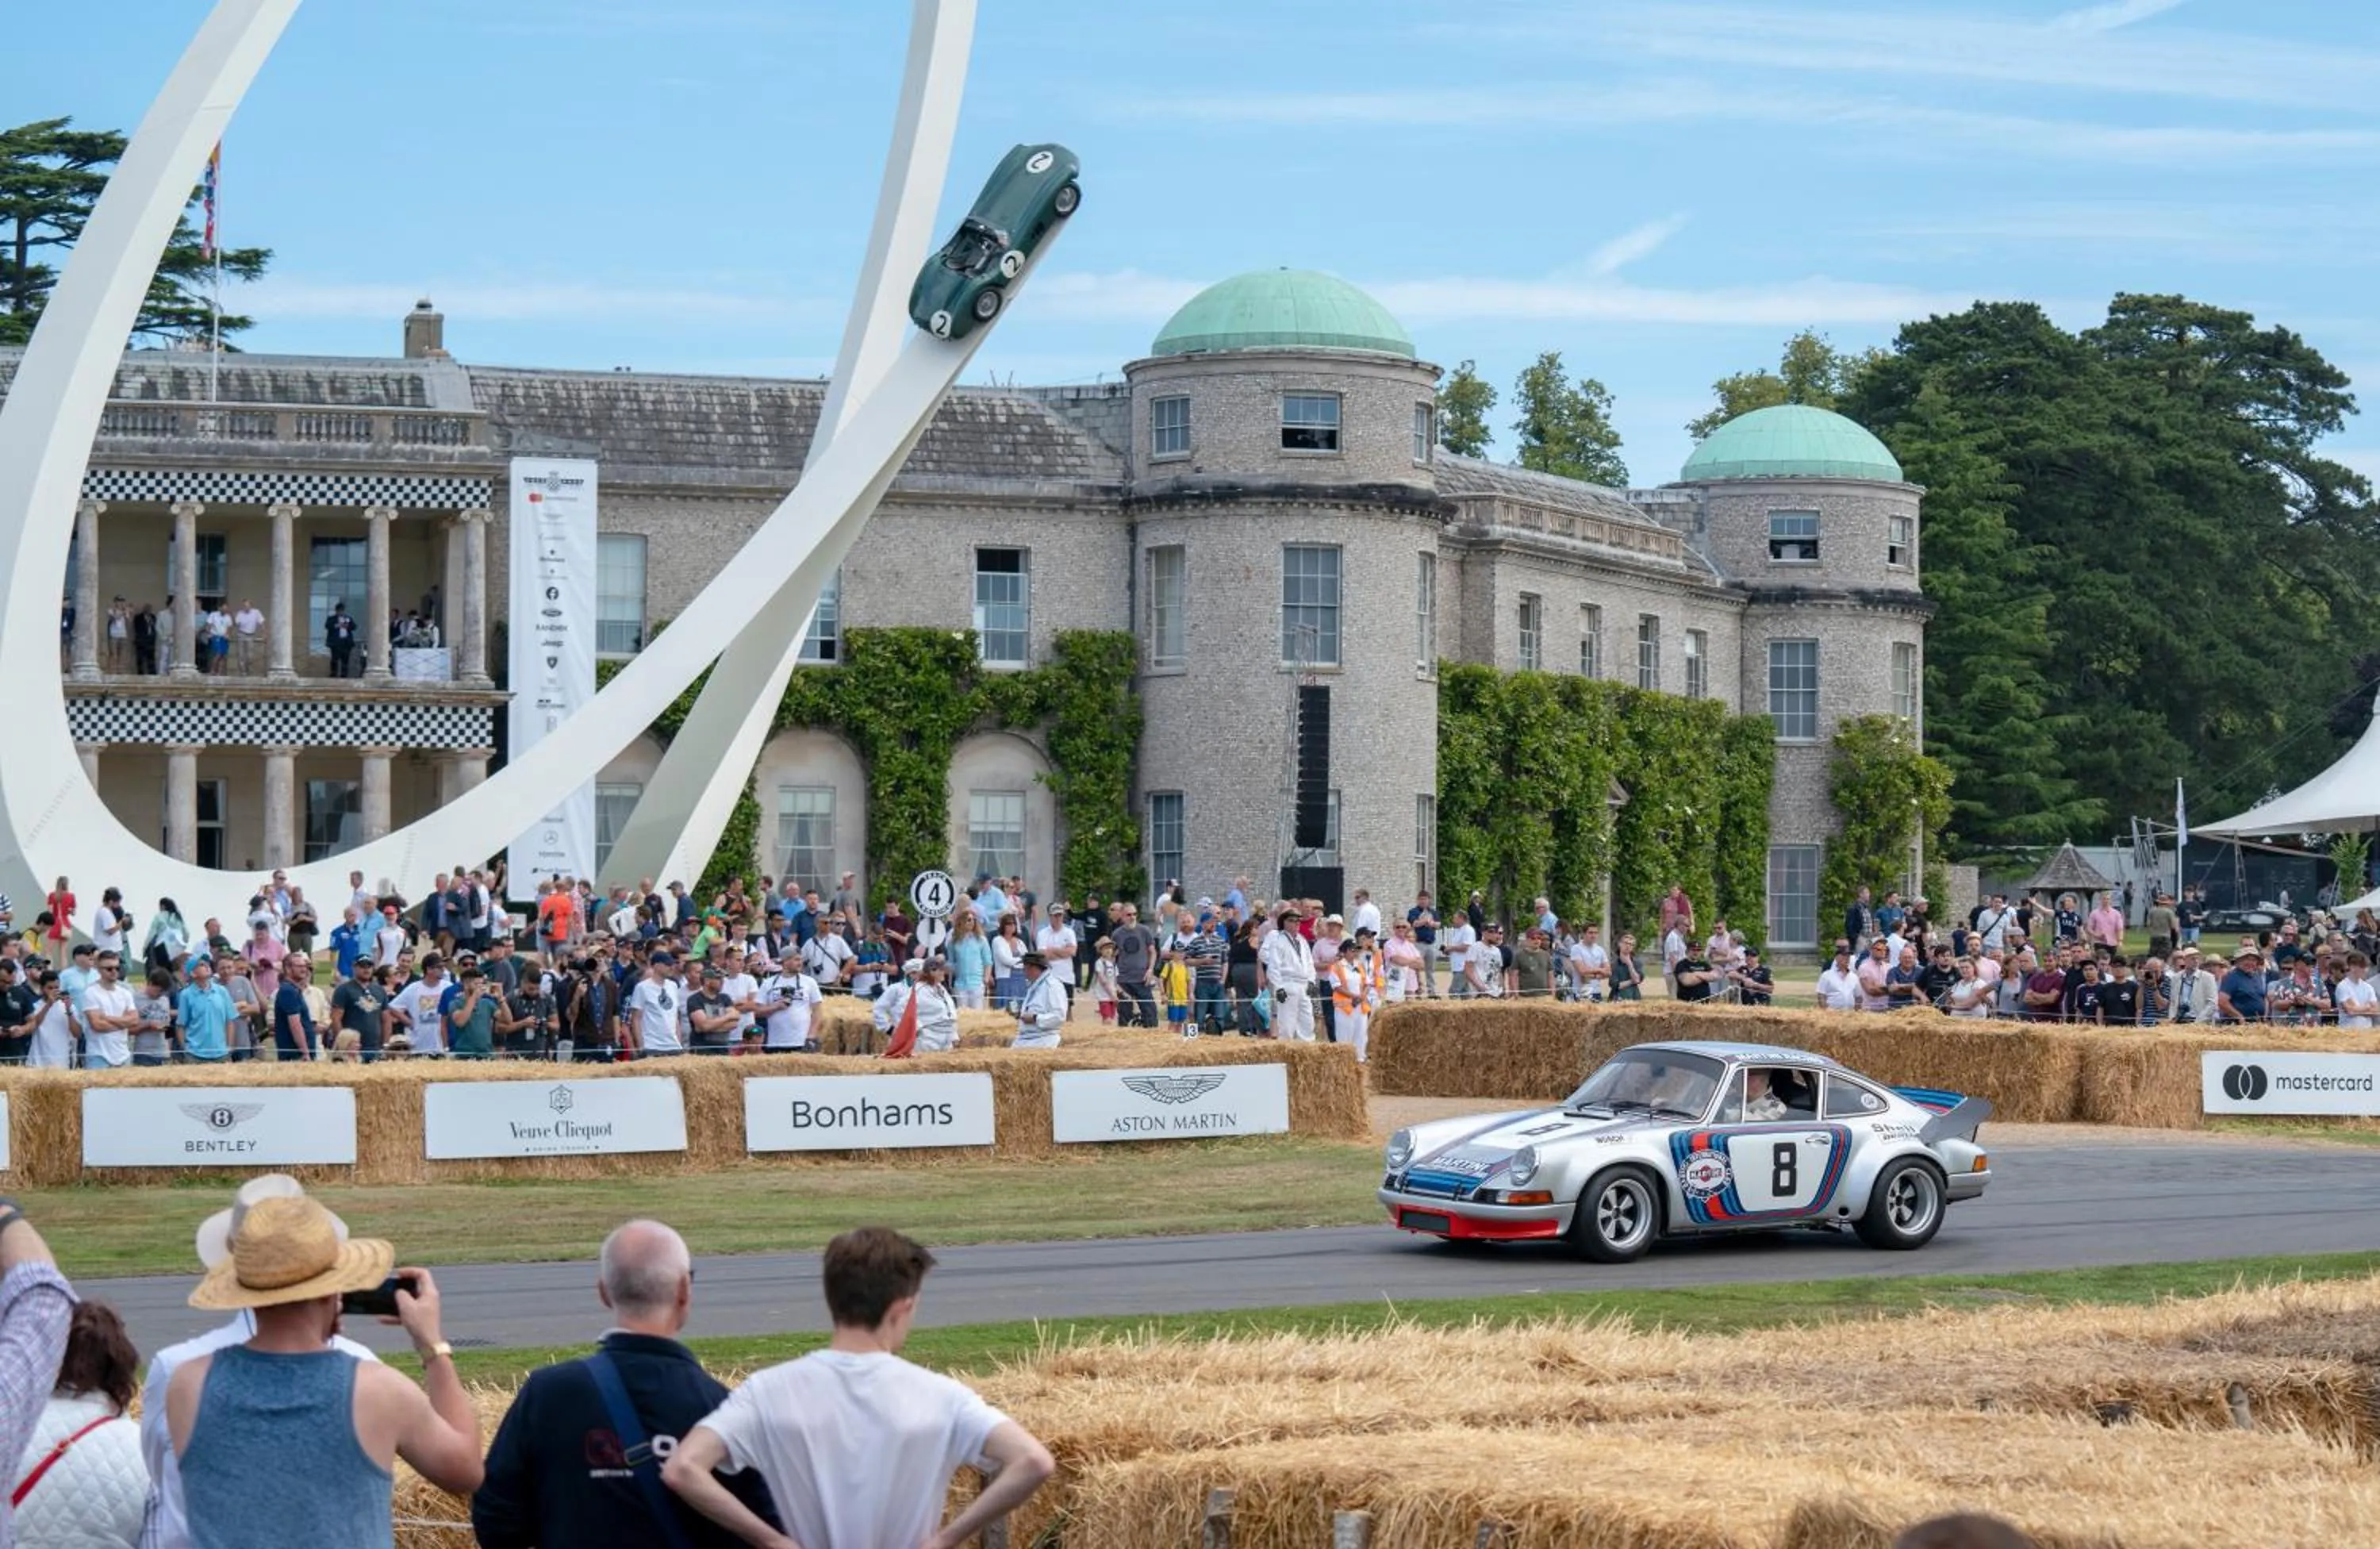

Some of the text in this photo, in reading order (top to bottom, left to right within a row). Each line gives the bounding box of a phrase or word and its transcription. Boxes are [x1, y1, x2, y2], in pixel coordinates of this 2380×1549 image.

[1004, 255, 1022, 273] 2
[935, 314, 947, 335] 2
[927, 882, 941, 905] 4
[2276, 1074, 2373, 1091] mastercard
[792, 1097, 953, 1128] Bonhams
[1111, 1113, 1237, 1132] ASTON MARTIN
[510, 1120, 612, 1140] Veuve Clicquot
[185, 1140, 258, 1152] BENTLEY
[1772, 1142, 1797, 1197] 8
